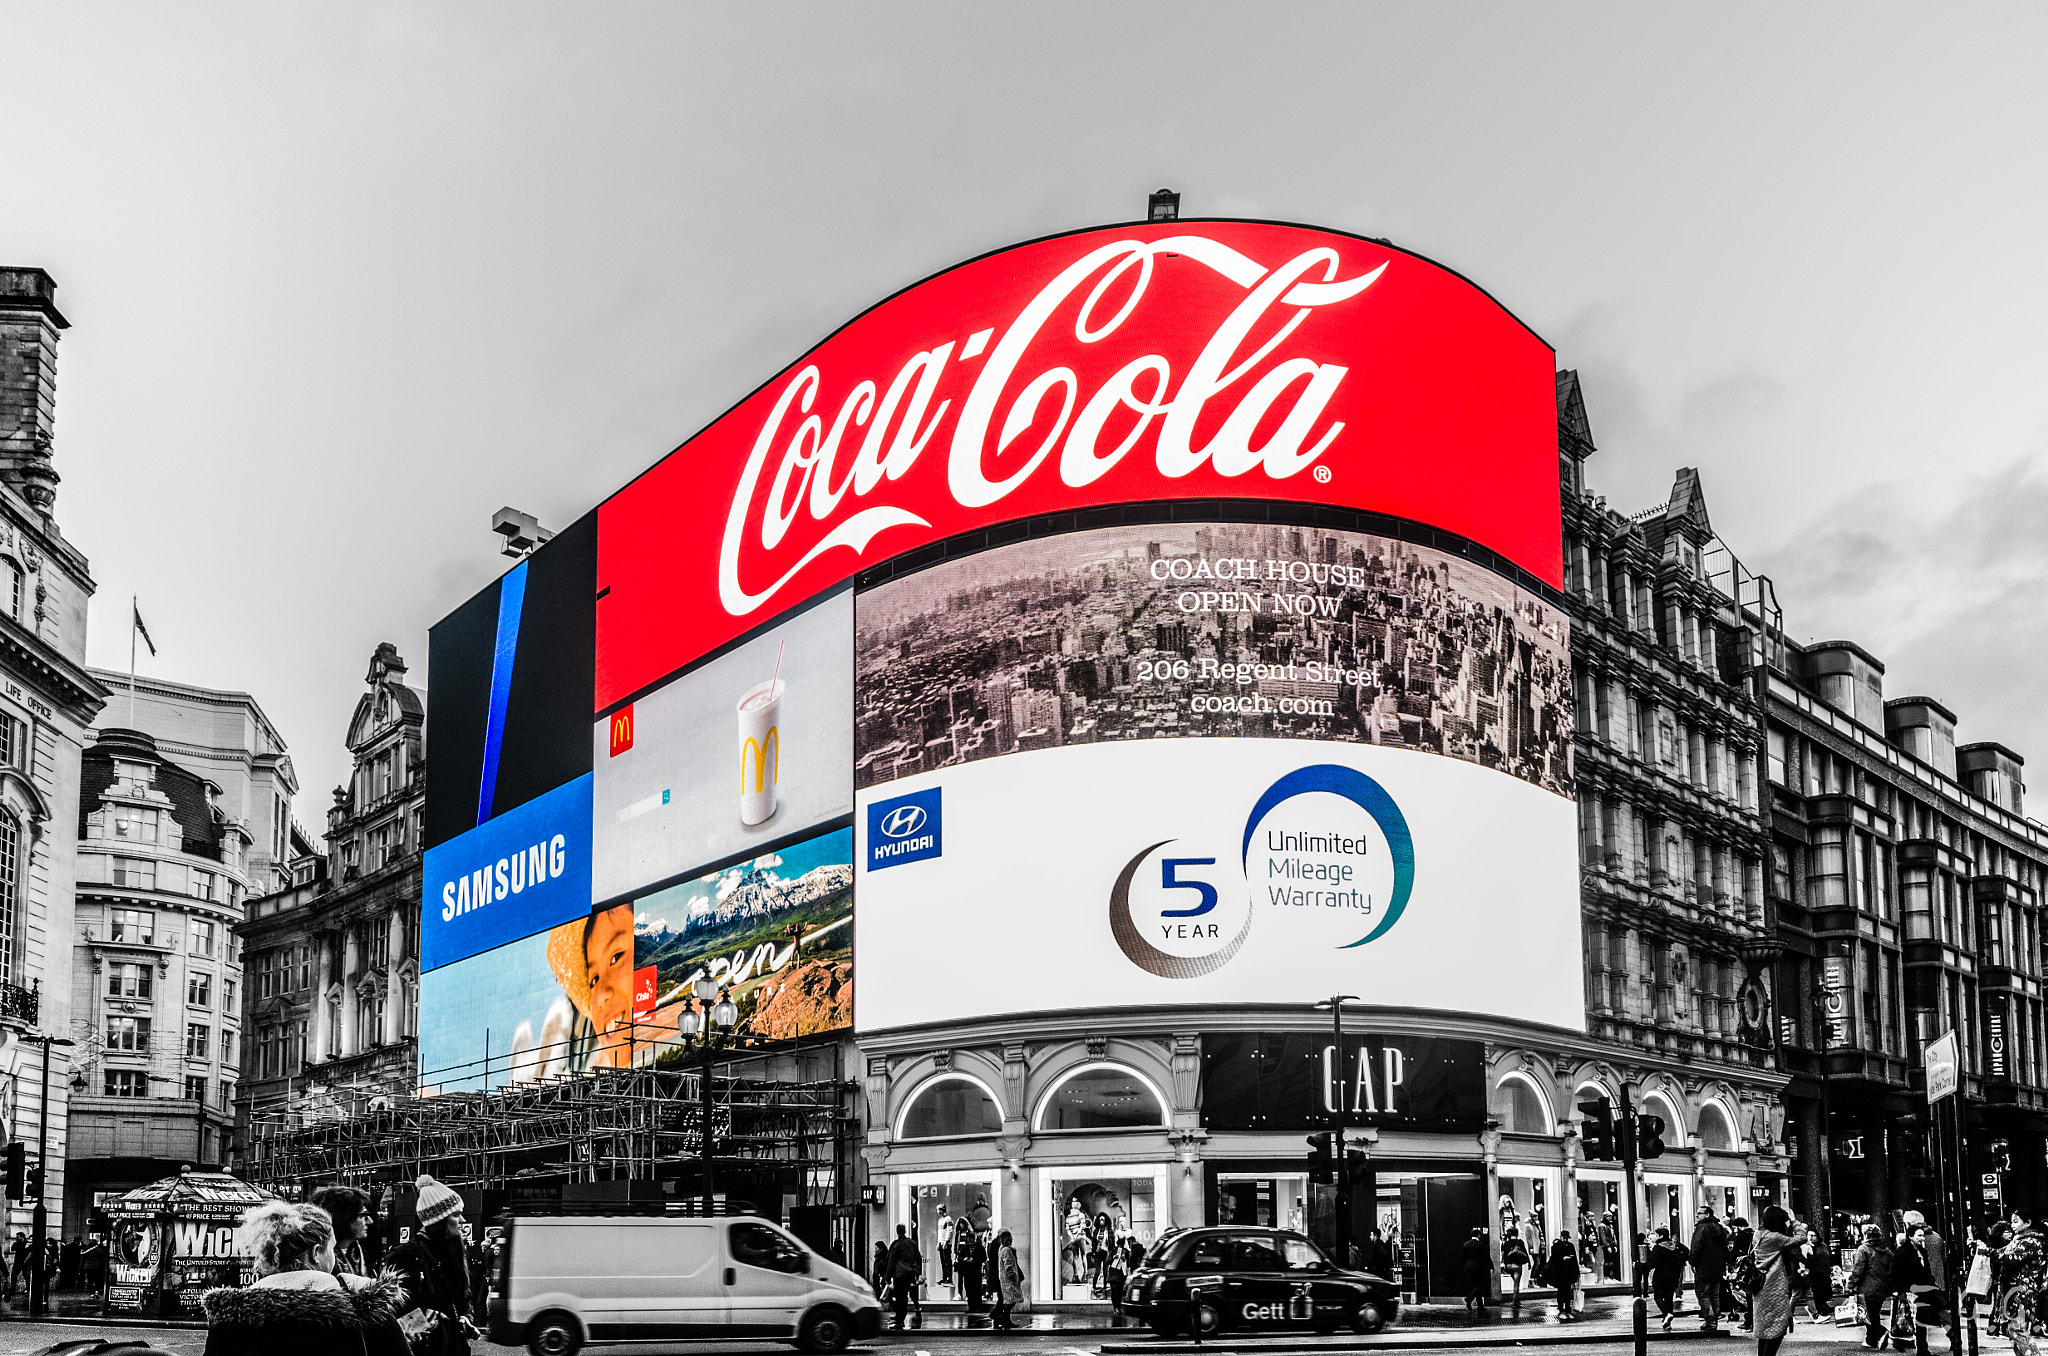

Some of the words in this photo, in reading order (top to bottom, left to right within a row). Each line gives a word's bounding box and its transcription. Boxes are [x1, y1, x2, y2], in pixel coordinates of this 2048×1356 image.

[718, 235, 1390, 616] Coca-Cola
[1150, 558, 1257, 581] COACH
[1266, 560, 1365, 588] HOUSE
[1178, 591, 1263, 613] OPEN
[1272, 593, 1344, 618] NOW
[1137, 659, 1189, 682] 206
[1198, 658, 1298, 684] Regent
[1305, 660, 1382, 689] Street
[5, 681, 21, 701] LIFE
[28, 697, 51, 720] OFFICE
[1191, 692, 1335, 716] coach.com
[875, 835, 934, 860] HYUNDAI
[1268, 830, 1367, 855] Unlimited
[442, 834, 565, 922] SAMSUNG
[1269, 858, 1353, 886] Mileage
[1161, 857, 1218, 917] 5
[1268, 885, 1372, 915] Warranty
[1161, 924, 1219, 939] YEAR
[1323, 1045, 1403, 1113] GAP
[203, 1204, 223, 1212] BEST
[173, 1221, 246, 1258] WIC
[239, 1272, 259, 1285] 100
[1242, 1302, 1285, 1320] Gett
